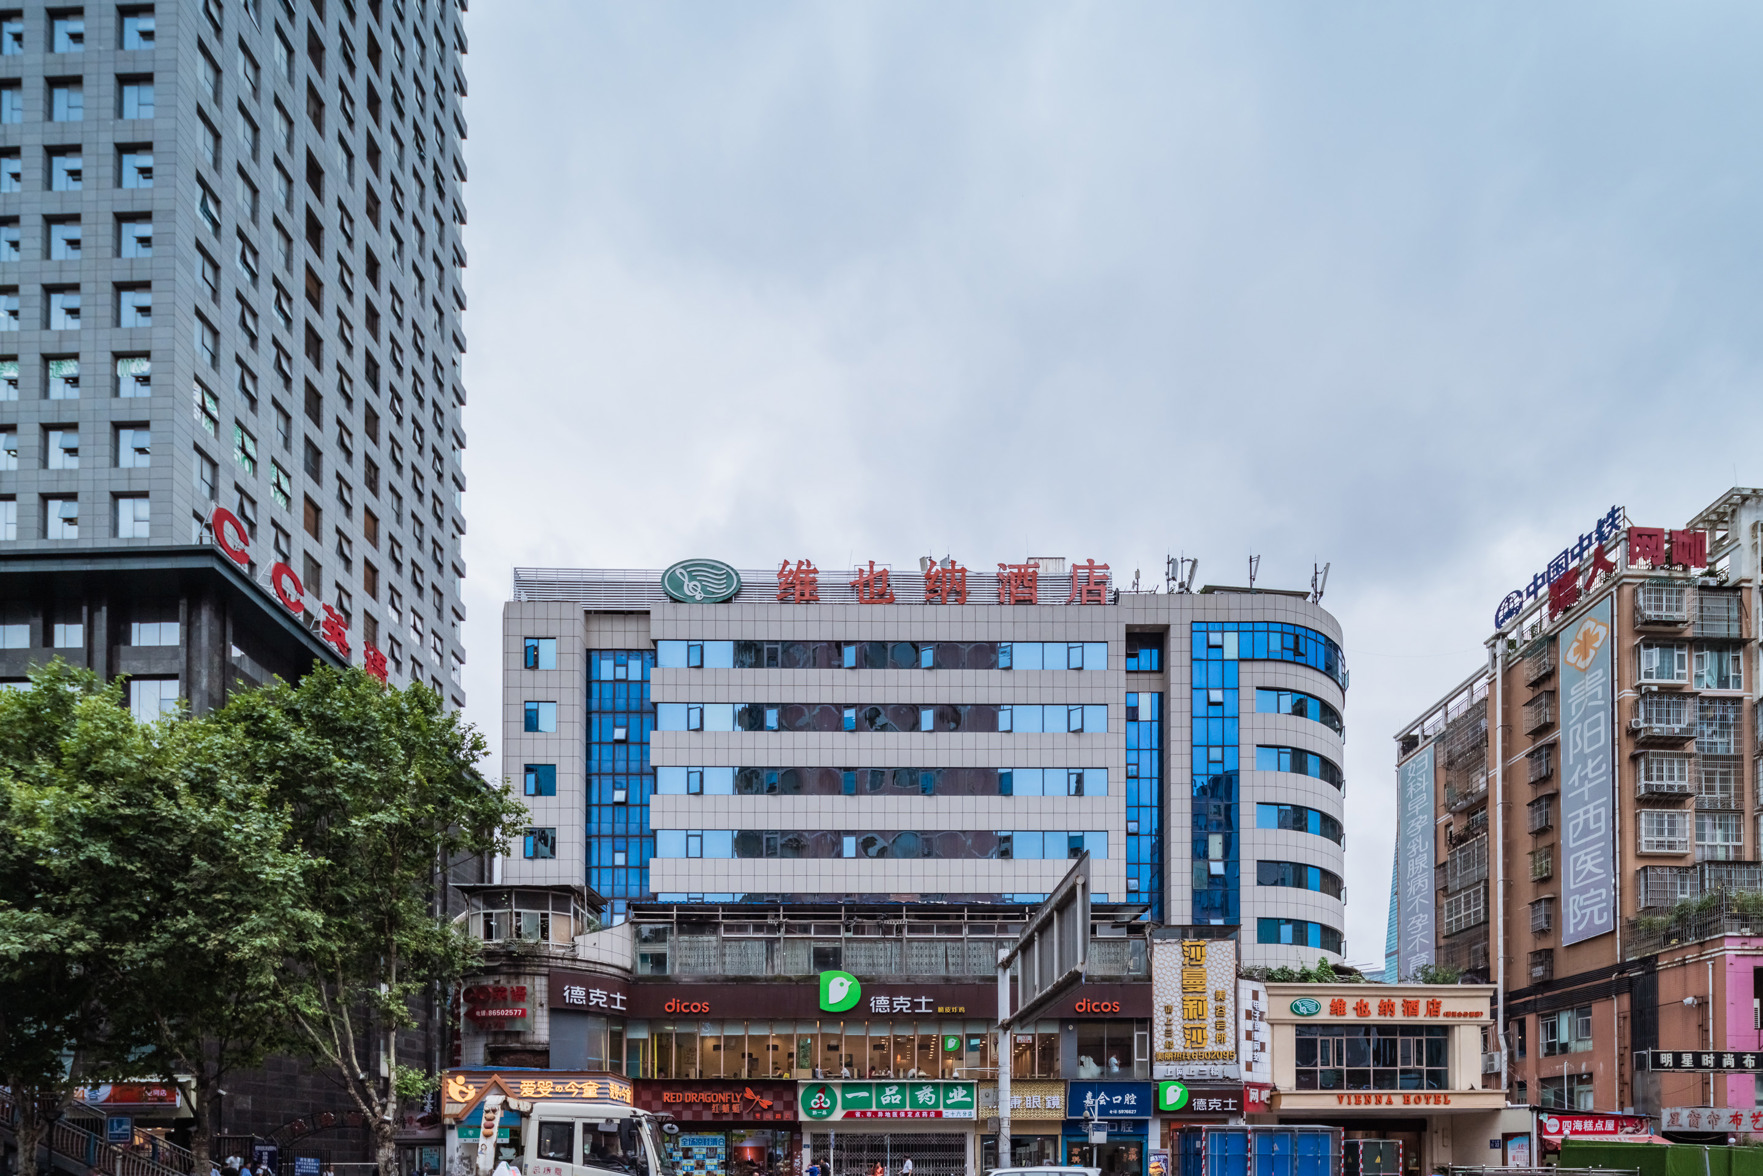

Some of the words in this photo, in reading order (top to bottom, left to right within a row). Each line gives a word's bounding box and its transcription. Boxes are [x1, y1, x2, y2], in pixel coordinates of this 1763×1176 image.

[1525, 505, 1622, 601] 中国中铁
[776, 558, 1111, 605] 维也纳酒店
[1568, 667, 1608, 934] 贵阳华西医院
[563, 985, 627, 1011] 德克士
[1182, 940, 1209, 1050] 莎曼莉莎
[664, 998, 710, 1014] dicos
[869, 996, 934, 1013] 德克士
[1075, 998, 1120, 1013] dicos
[1329, 998, 1443, 1018] 维也纳酒店
[1215, 990, 1227, 1045] 美容会所
[1660, 1053, 1756, 1069] 明星时尚布
[663, 1092, 683, 1103] RED
[684, 1092, 743, 1103] DRAGONFLY
[845, 1085, 971, 1105] 一品药业
[1248, 1088, 1271, 1104] 网吧
[1337, 1094, 1393, 1105] VIENNA
[1403, 1094, 1451, 1105] HOTEL
[711, 1103, 741, 1114] 红蜻蜓
[1192, 1098, 1237, 1111] 德克士
[1562, 1119, 1615, 1132] 四海糕点屋
